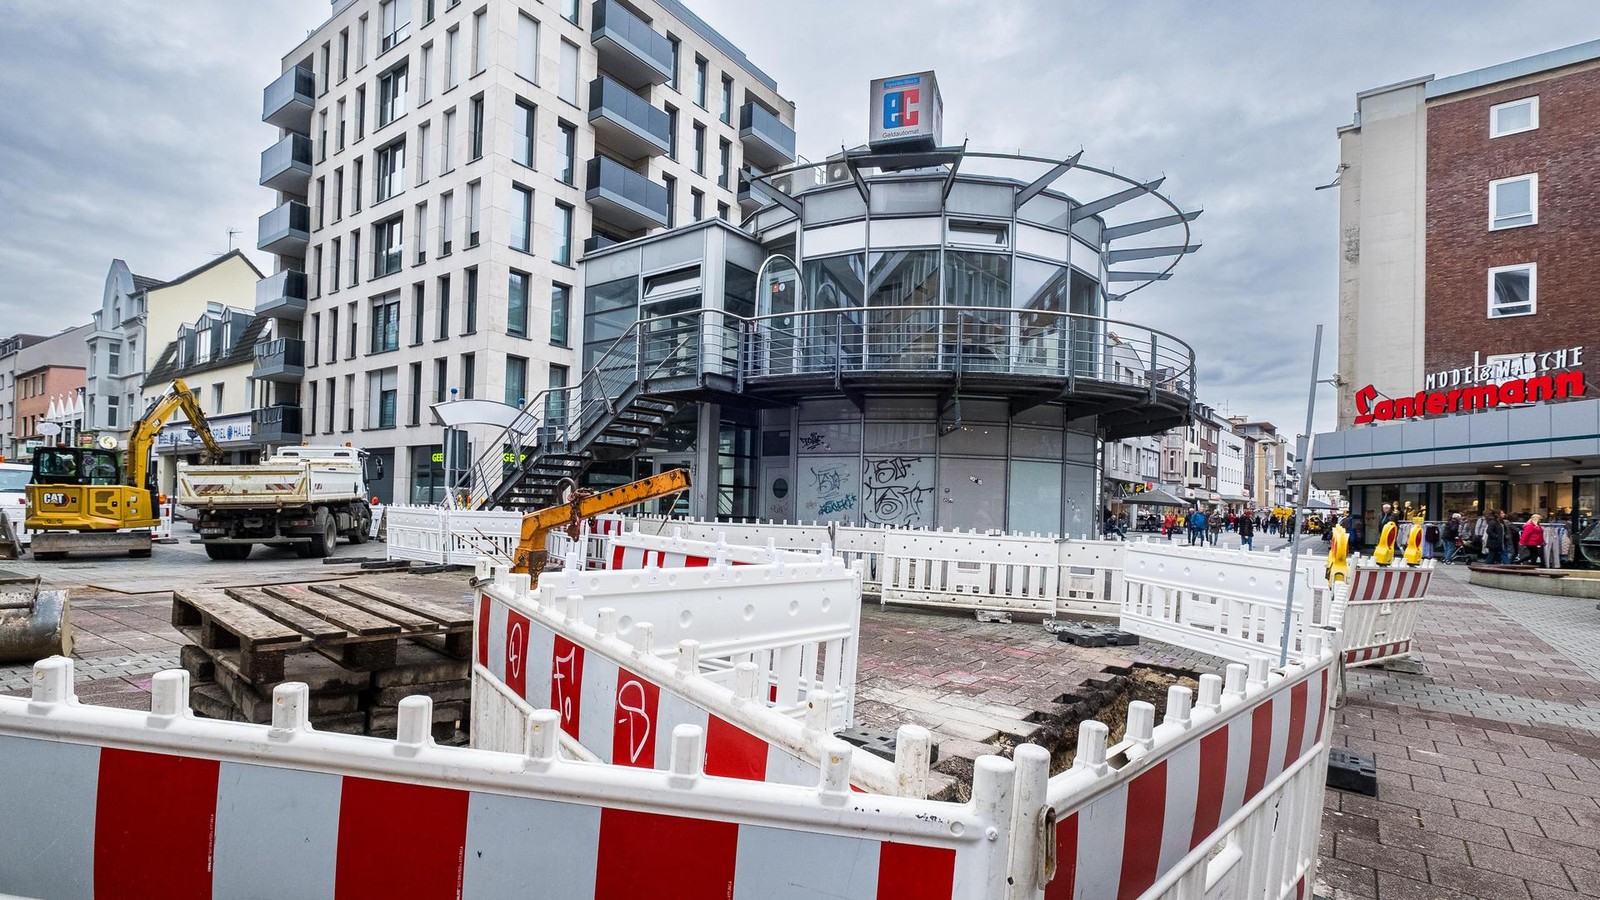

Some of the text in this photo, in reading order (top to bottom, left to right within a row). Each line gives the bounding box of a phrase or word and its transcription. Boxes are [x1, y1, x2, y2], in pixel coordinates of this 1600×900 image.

[882, 129, 919, 138] Geldautomat
[1426, 367, 1474, 390] MODE
[1480, 366, 1492, 381] &
[233, 424, 251, 438] HALLE
[431, 453, 444, 462] GEE
[43, 493, 64, 504] CAT
